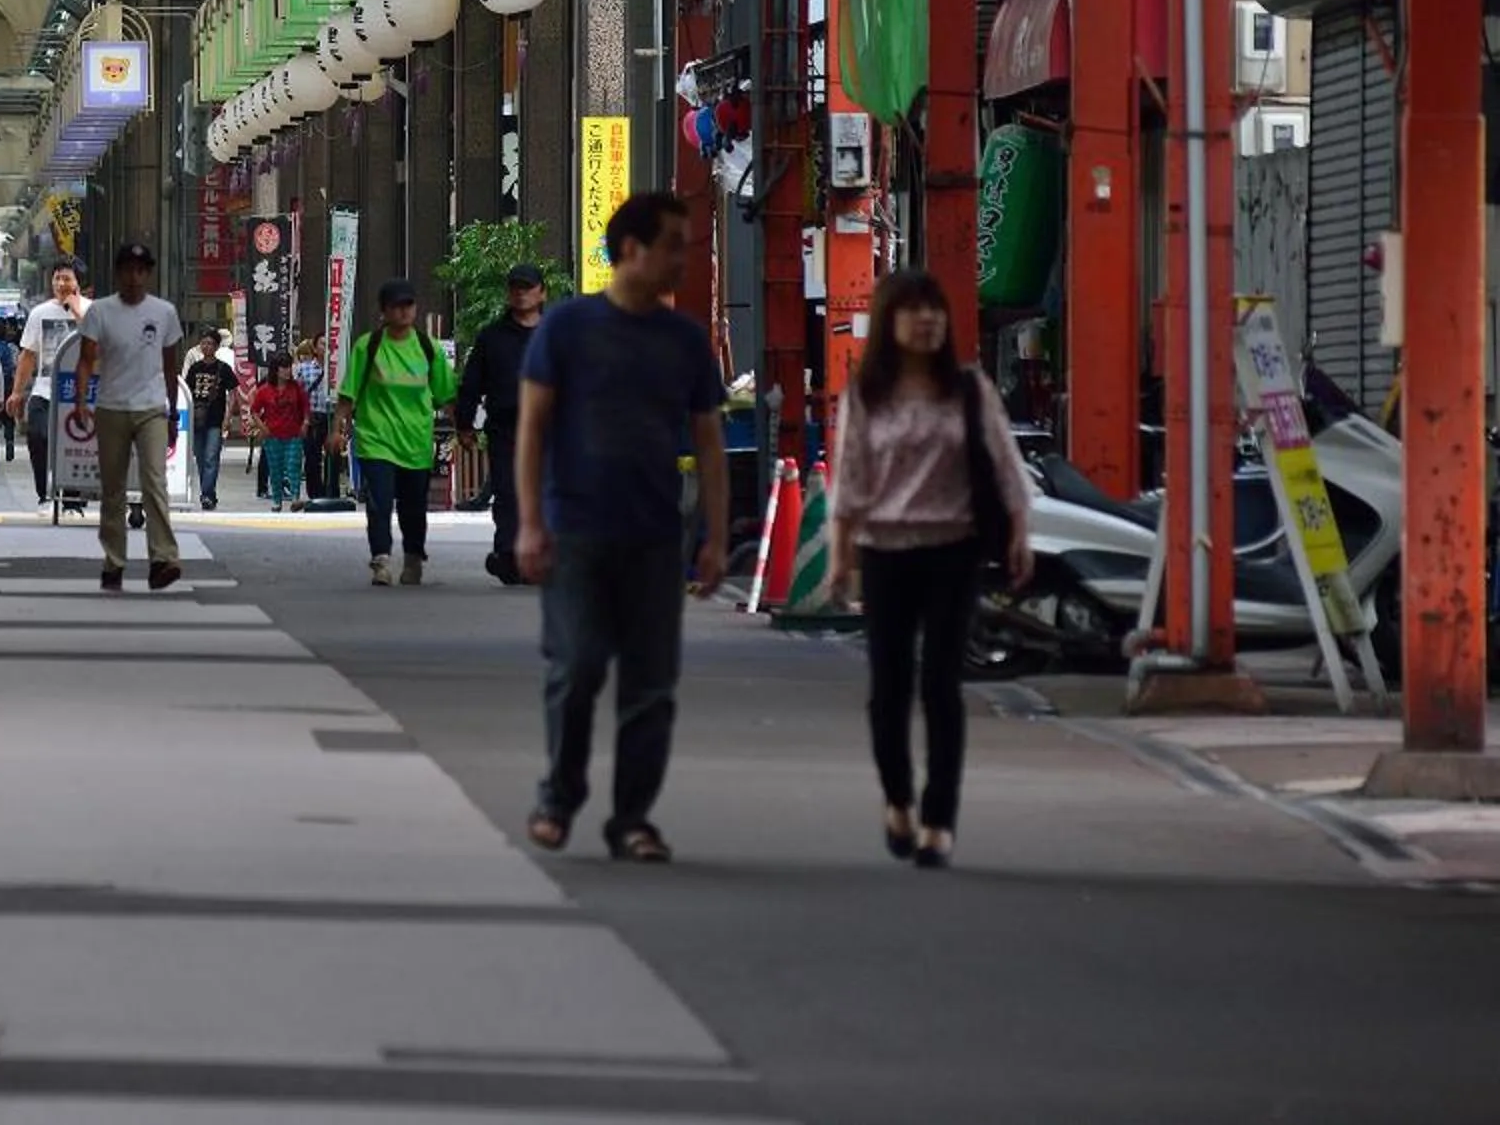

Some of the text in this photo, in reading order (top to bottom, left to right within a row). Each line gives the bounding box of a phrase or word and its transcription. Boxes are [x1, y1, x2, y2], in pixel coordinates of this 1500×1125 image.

[588, 124, 603, 232] ご通行ください
